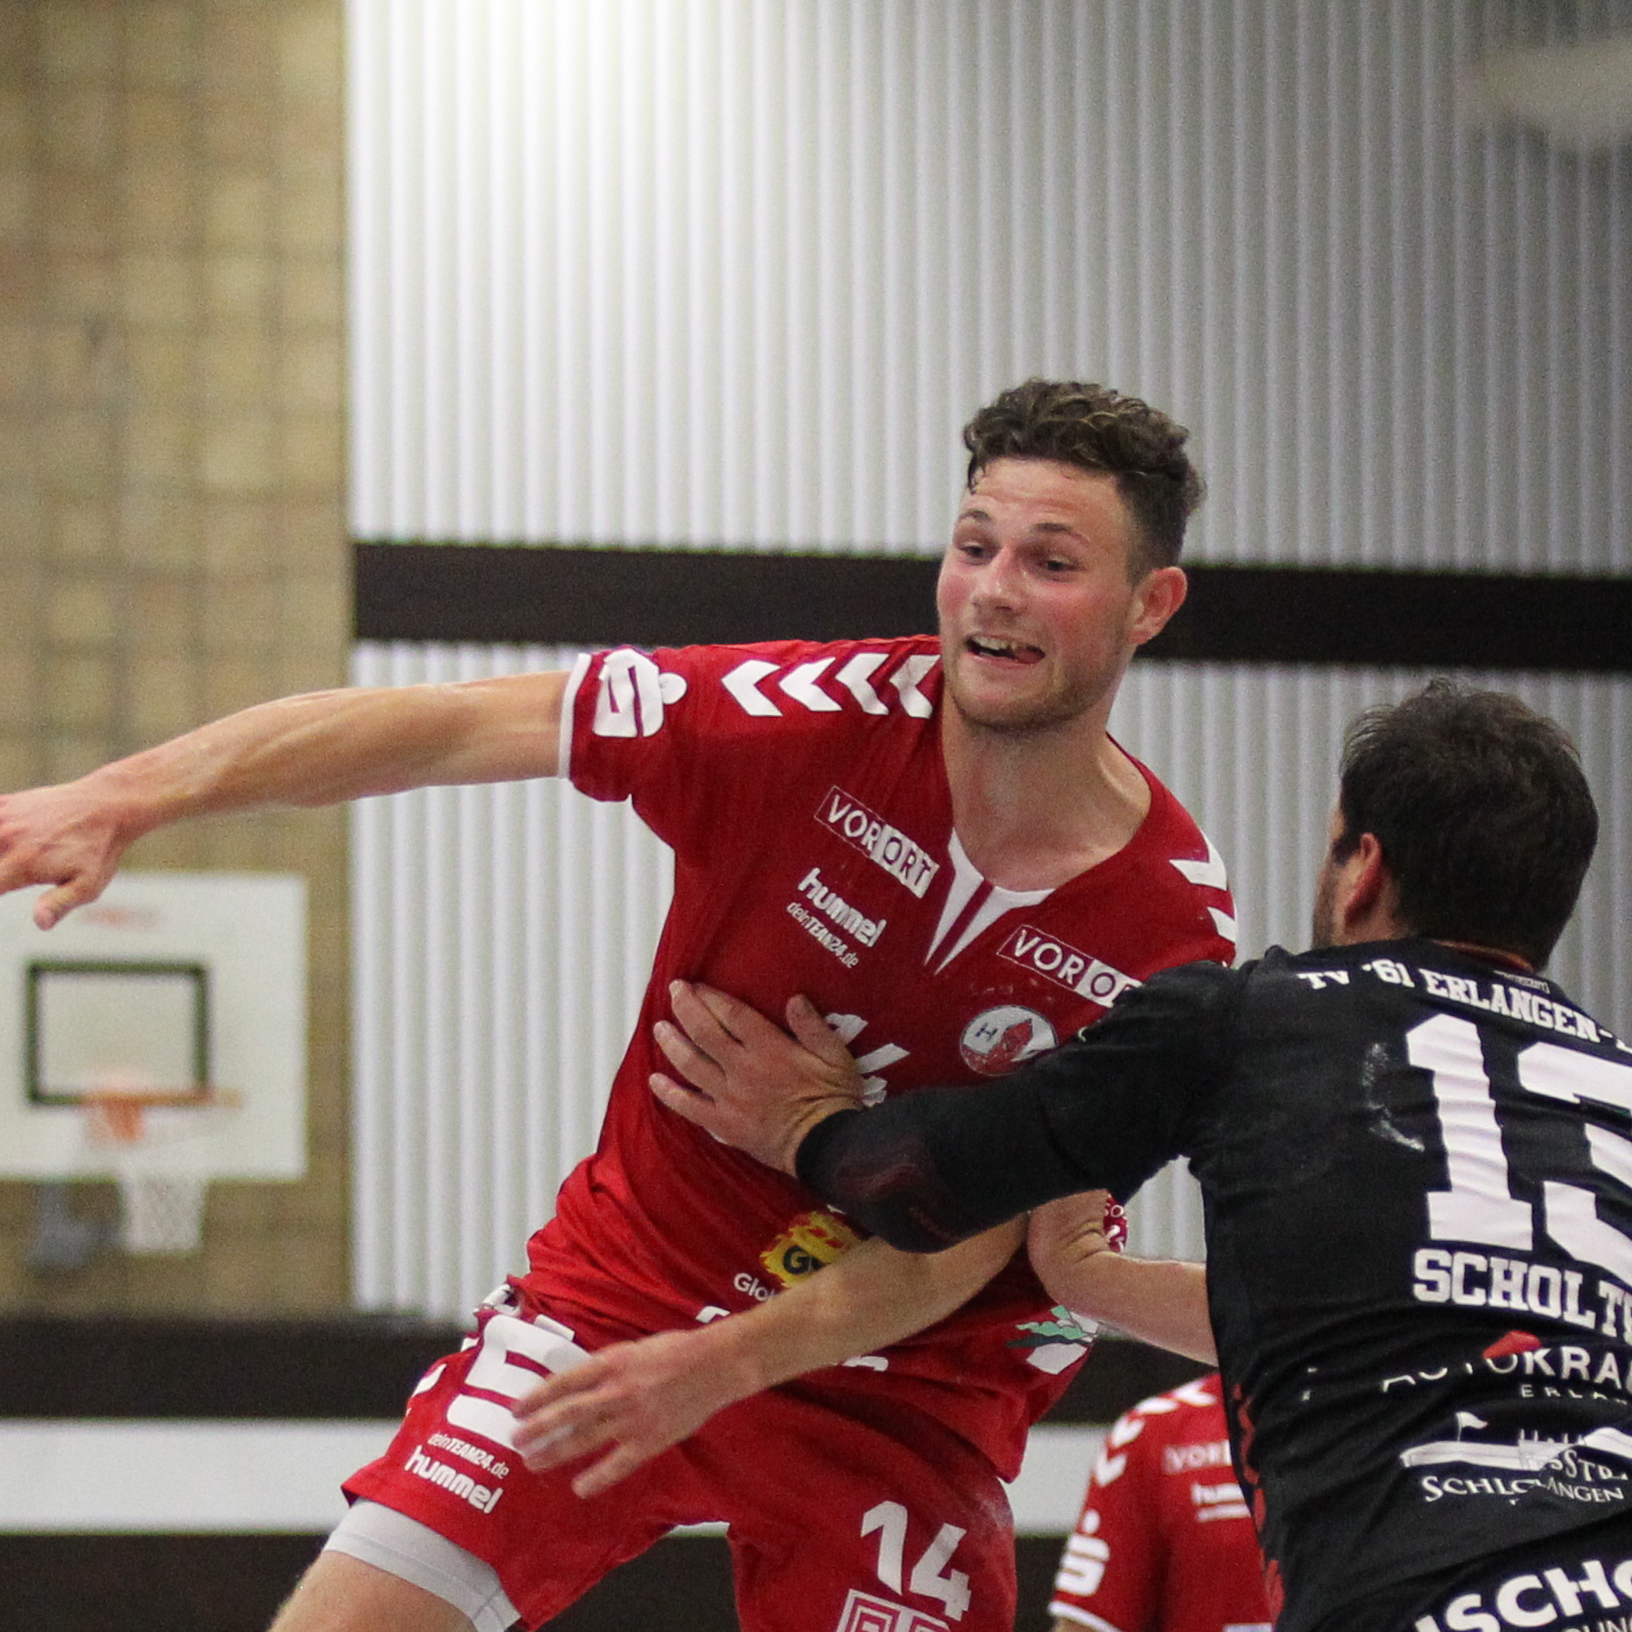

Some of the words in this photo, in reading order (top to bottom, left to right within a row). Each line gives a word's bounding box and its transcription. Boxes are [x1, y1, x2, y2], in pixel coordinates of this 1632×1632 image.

[827, 793, 935, 892] VORORT
[798, 868, 887, 948] hummel
[404, 1445, 504, 1514] hummel
[860, 1500, 971, 1621] 14
